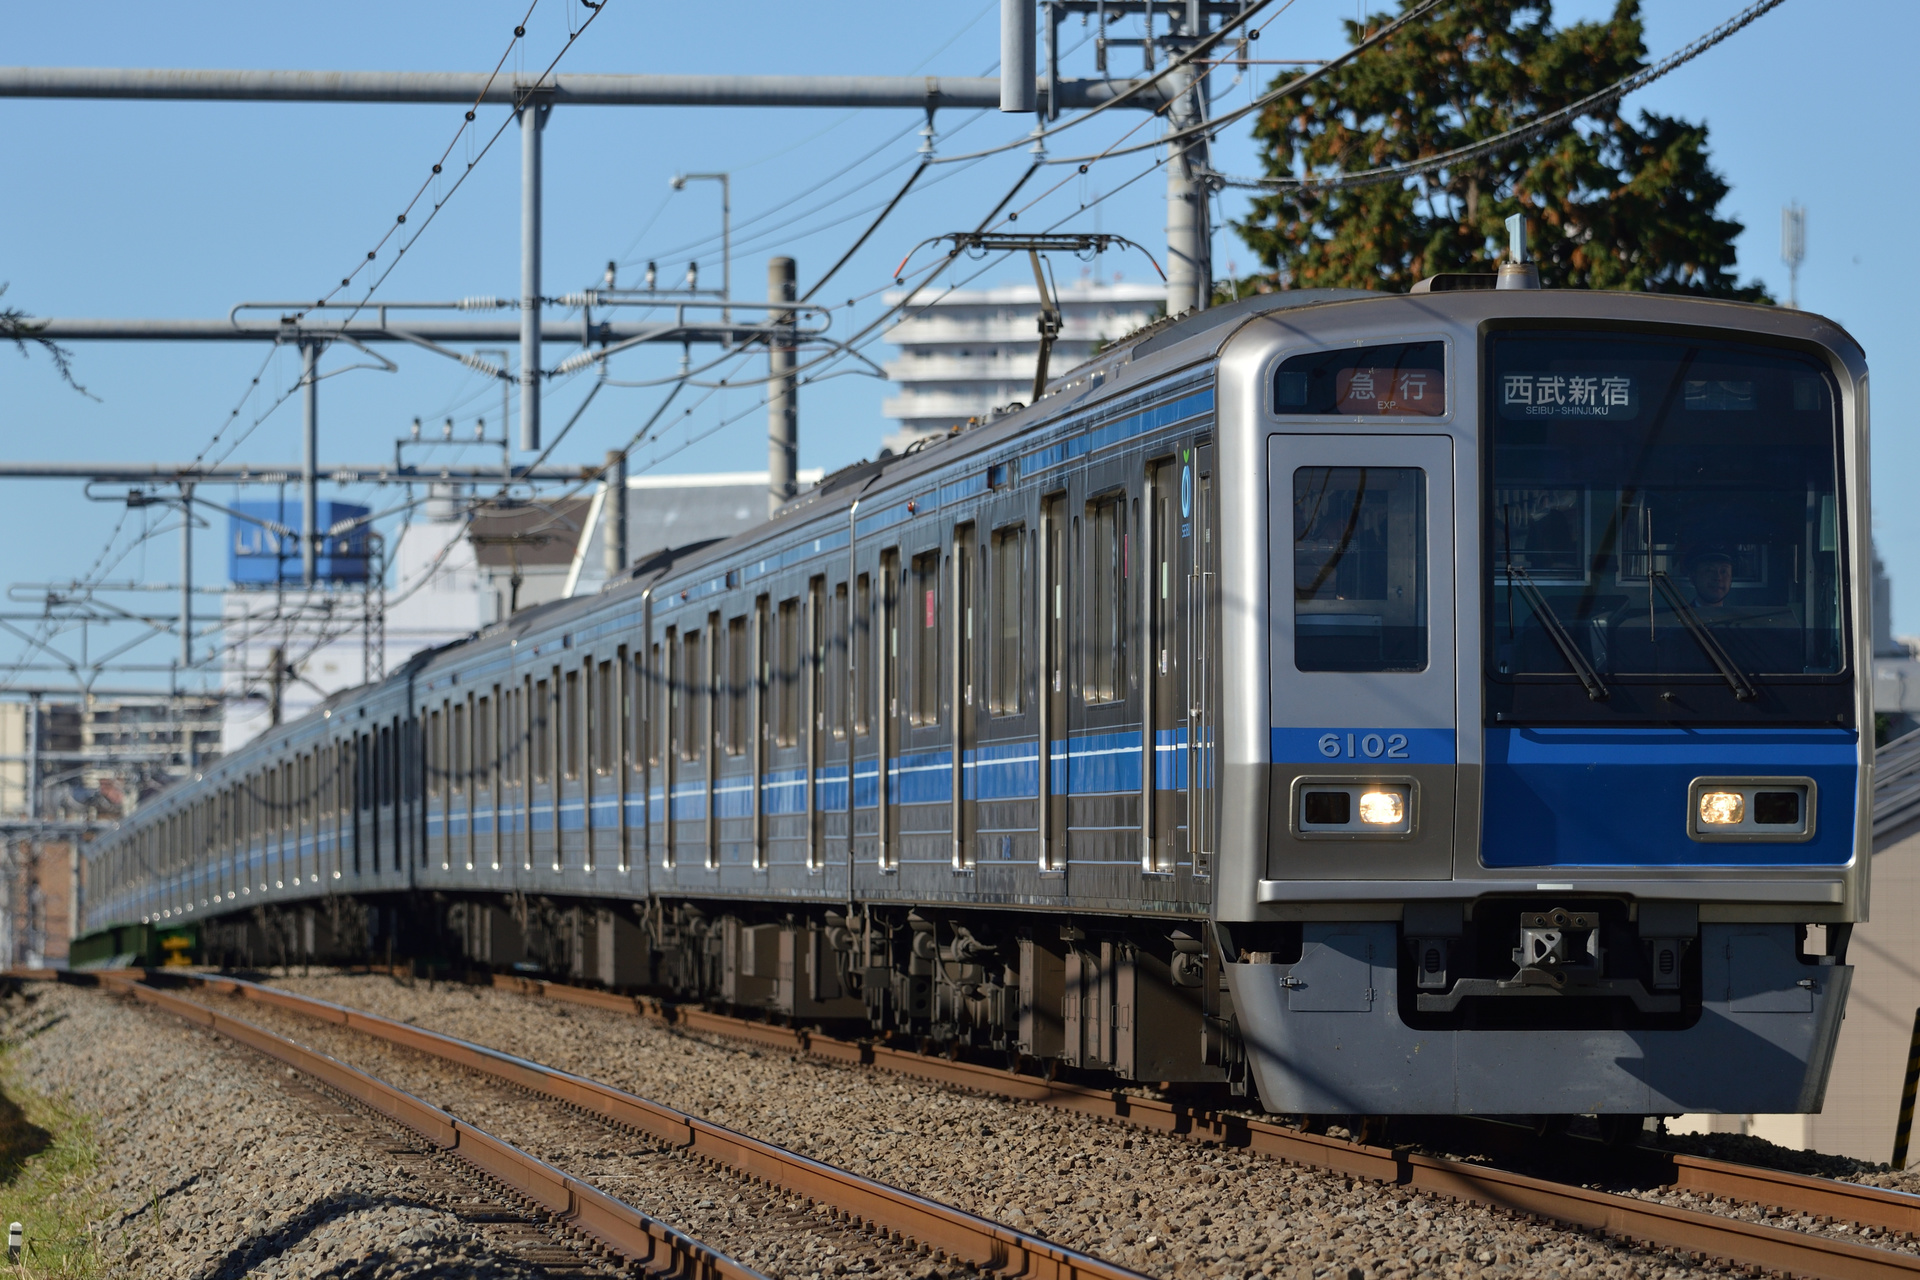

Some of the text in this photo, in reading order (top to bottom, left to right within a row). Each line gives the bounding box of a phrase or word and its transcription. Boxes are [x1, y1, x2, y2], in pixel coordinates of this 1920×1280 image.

[1503, 375, 1631, 406] 西武新宿
[1525, 406, 1609, 416] SEIBU-SHINJUKU
[1318, 733, 1410, 758] 6102
